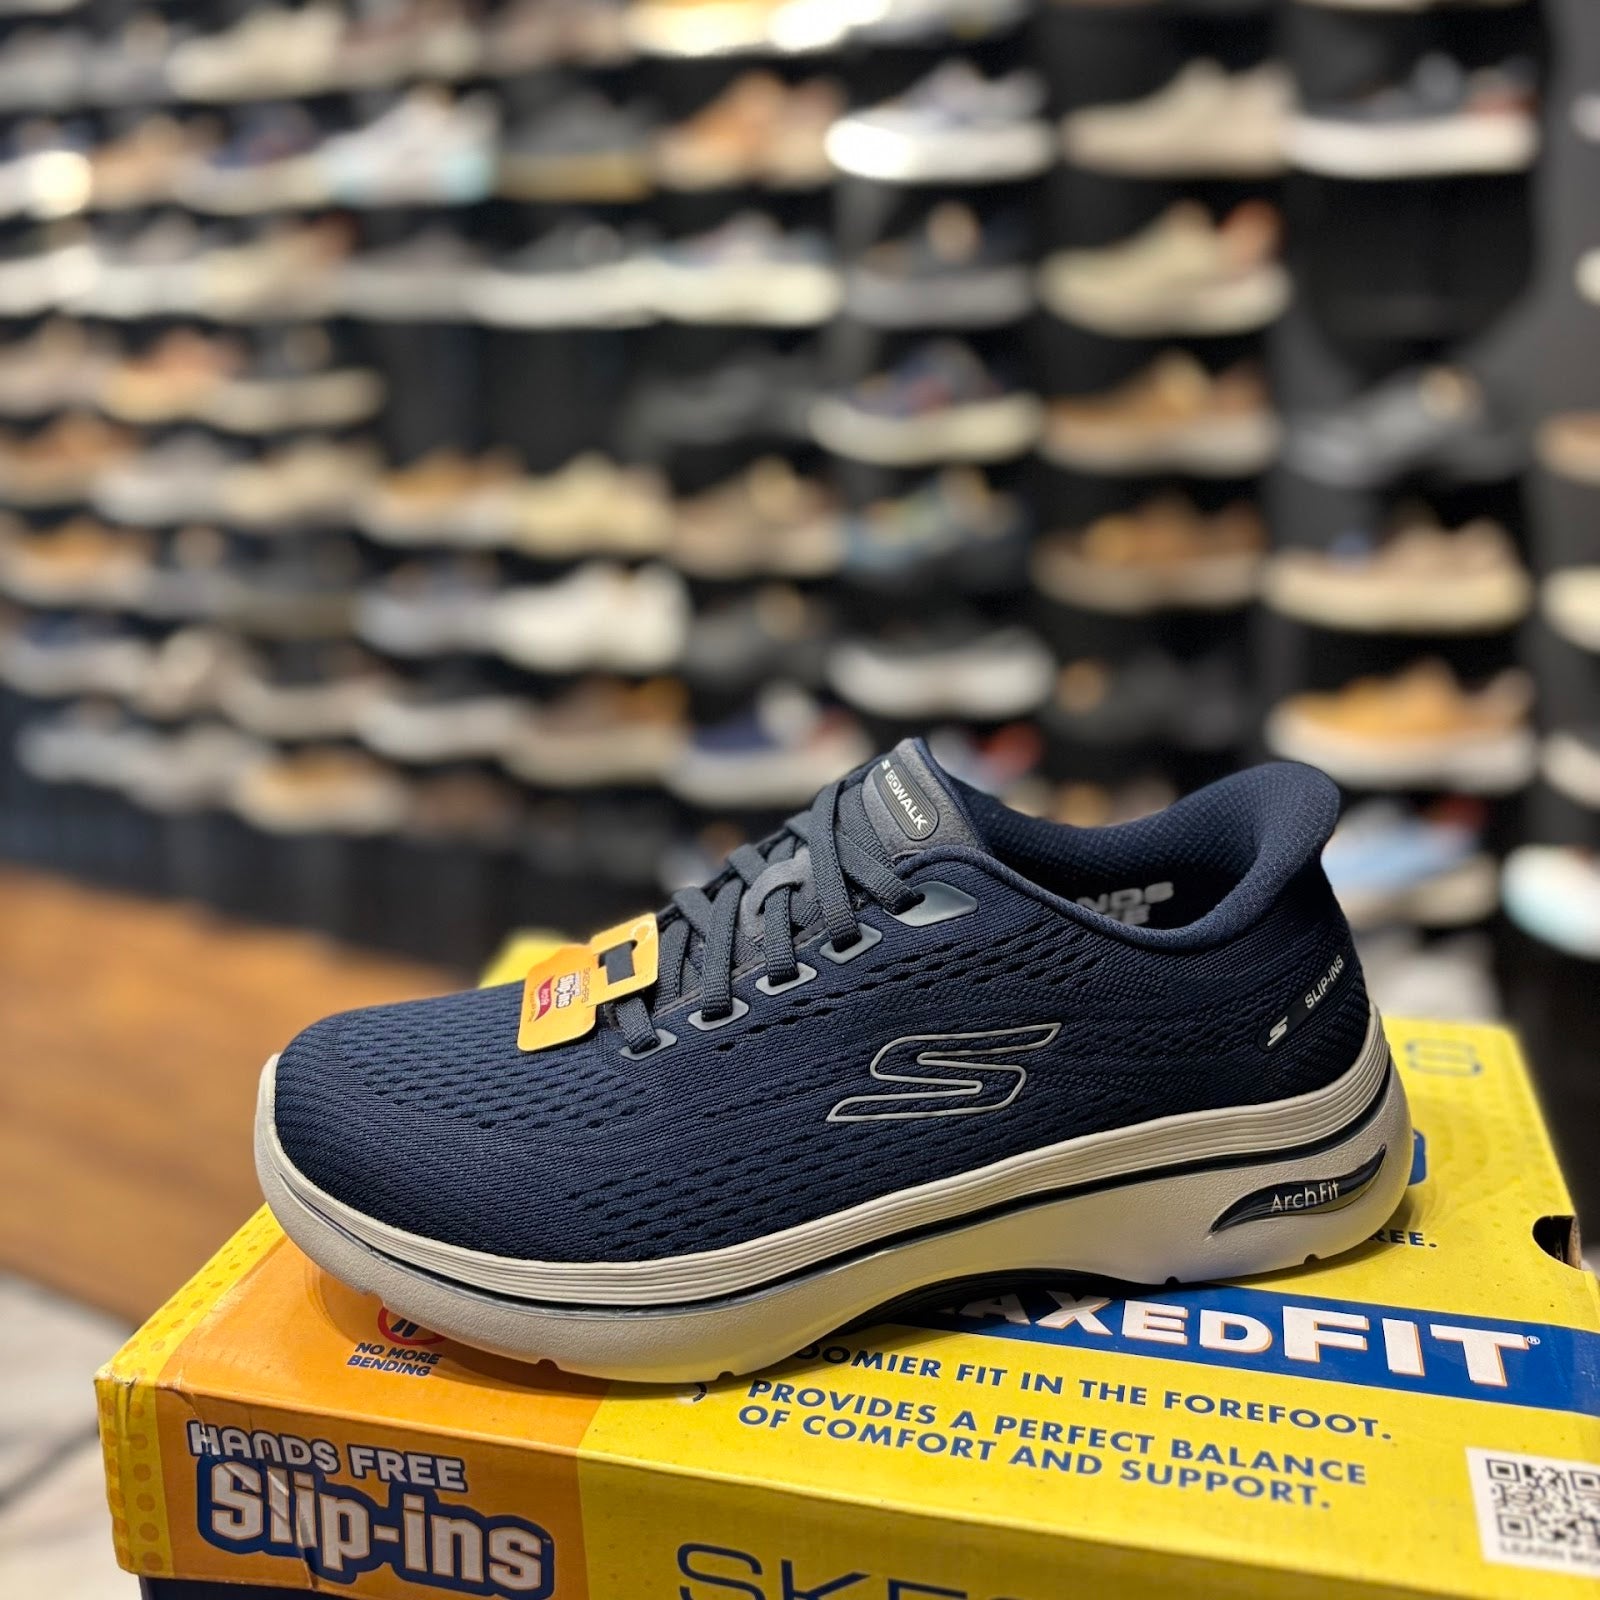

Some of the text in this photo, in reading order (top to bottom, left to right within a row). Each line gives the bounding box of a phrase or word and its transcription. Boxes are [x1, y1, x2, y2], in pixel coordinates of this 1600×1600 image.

[885, 769, 928, 831] GOWALK
[1304, 954, 1344, 1009] SLIP-INS
[1368, 1229, 1438, 1248] REE.
[347, 1354, 432, 1377] BENDING
[355, 1342, 442, 1365] NO MORE
[794, 1344, 1392, 1440] OOMIER FIT IN THE FOREFOOT.
[188, 1421, 467, 1492] HANDS FREE
[738, 1405, 1331, 1509] OF COMFORT AND SUPPORT.
[748, 1379, 1367, 1485] PROVIDES A PERFECT BALANCE
[210, 1461, 543, 1591] Slip-ins
